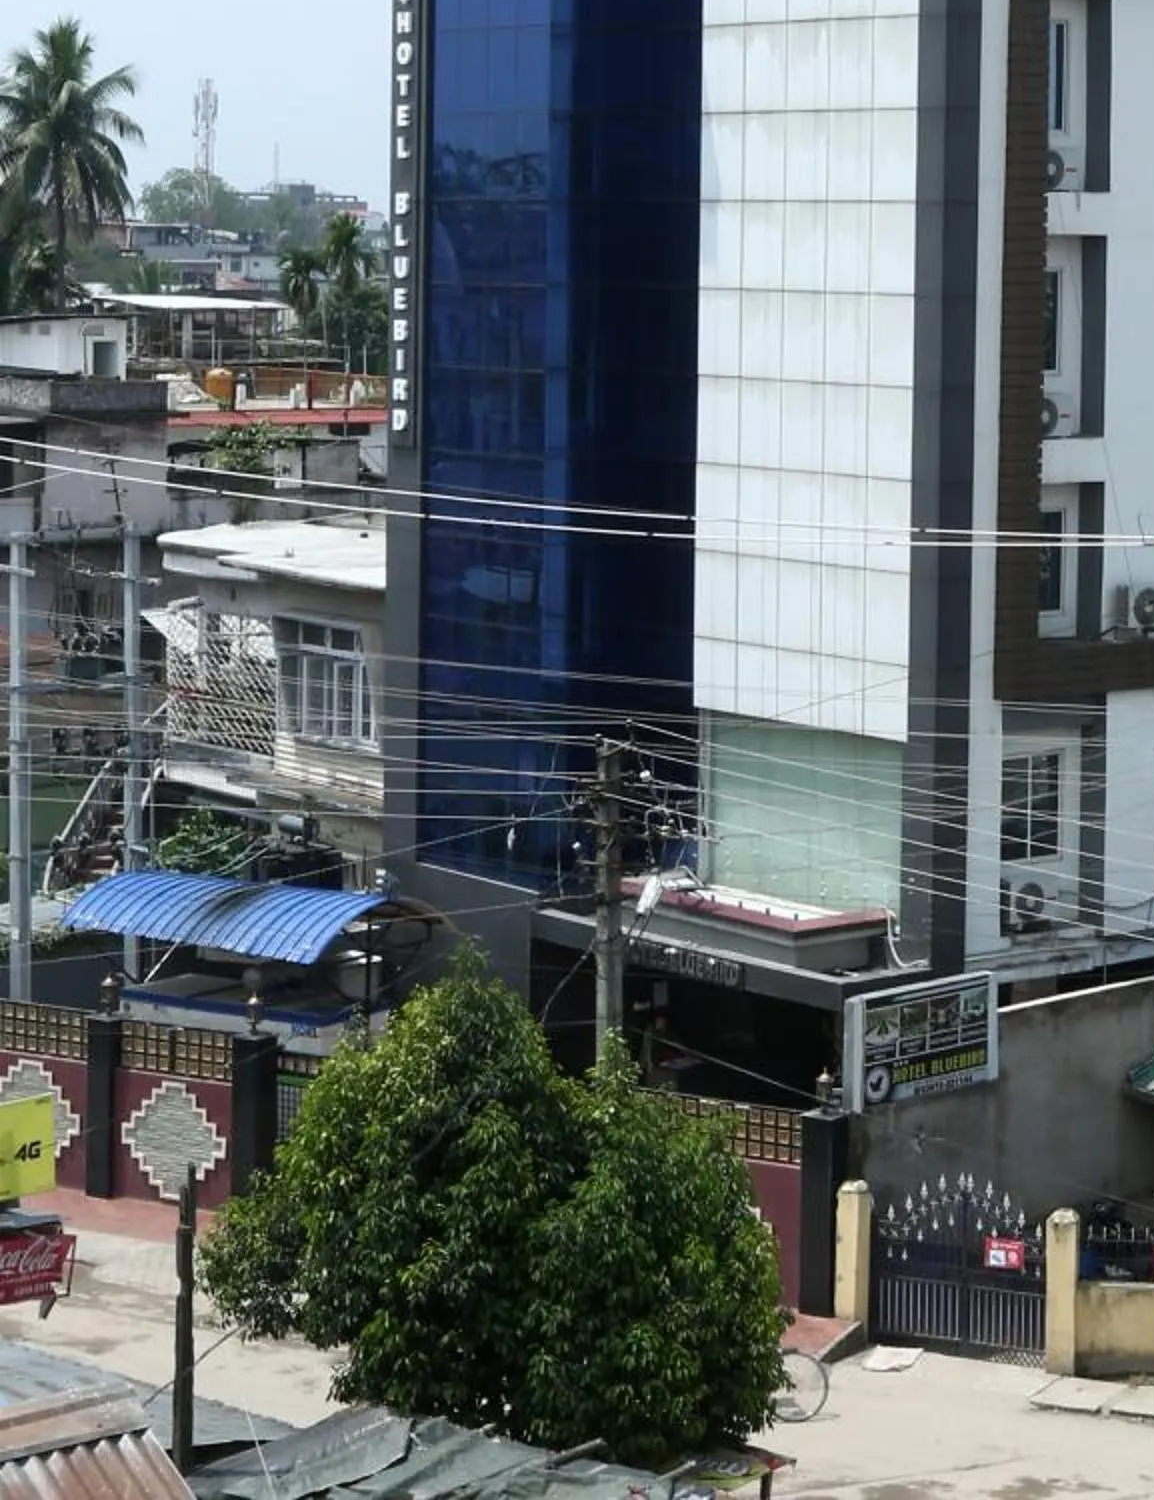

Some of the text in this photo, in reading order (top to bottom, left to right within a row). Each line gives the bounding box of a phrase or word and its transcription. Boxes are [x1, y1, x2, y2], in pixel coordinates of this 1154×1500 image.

[391, 11, 413, 431] HOTEL BLUEBIRD
[14, 1140, 41, 1161] 4G
